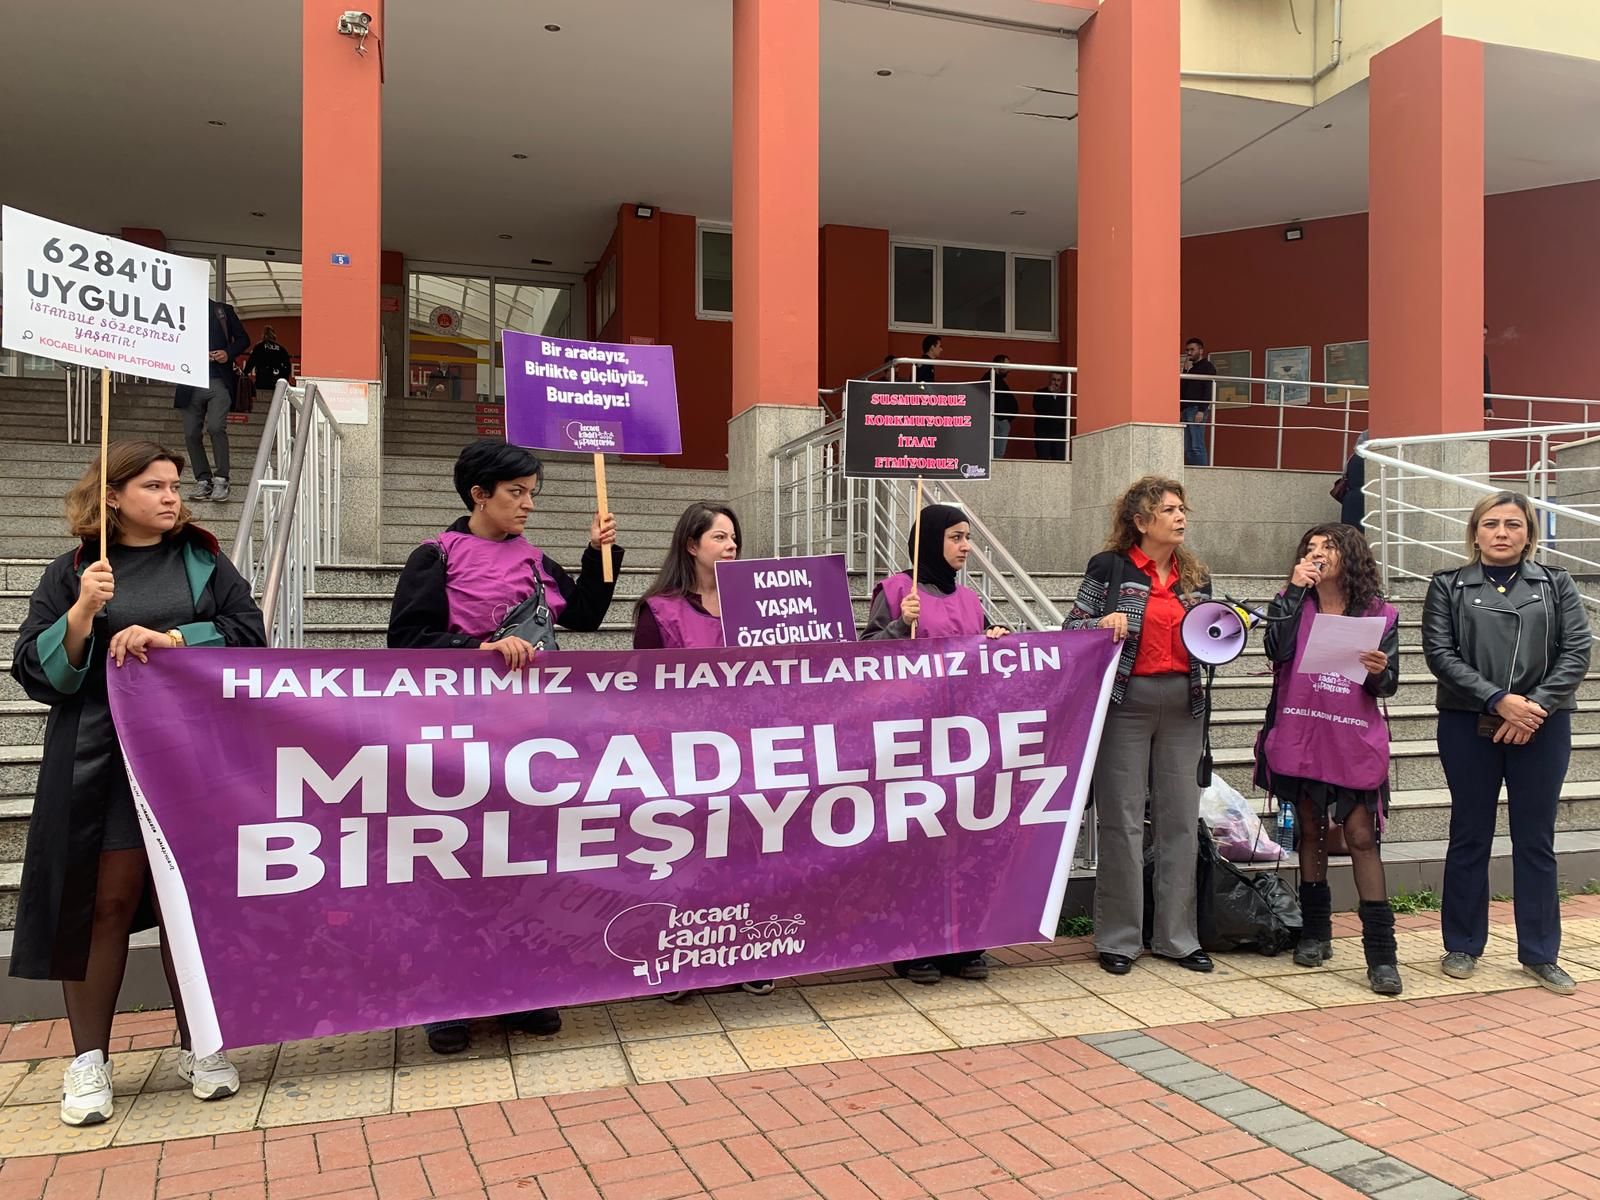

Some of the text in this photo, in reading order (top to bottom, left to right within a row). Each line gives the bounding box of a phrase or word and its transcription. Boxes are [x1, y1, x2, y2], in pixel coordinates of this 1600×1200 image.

[43, 237, 172, 291] 6284'Ü
[27, 268, 187, 331] UYGULA!
[30, 299, 181, 344] İSTANBUL SÖZLEŞMESİ
[74, 326, 137, 349] YAŞATIR!
[39, 336, 176, 372] KOCAELİ KADIN PLATFORMU
[541, 340, 629, 365] Bir aradayız,
[525, 360, 649, 387] Birlikte güçlüyüz,
[546, 386, 631, 410] Buradayız!
[870, 393, 967, 406] SUSMUYORUZ
[864, 414, 972, 427] KORKMUYORUZ
[897, 433, 938, 448] İTAAT
[874, 454, 959, 470] ETMİYORUZ!
[753, 569, 812, 589] KADIN,
[755, 596, 818, 618] YAŞAM,
[737, 620, 833, 647] ÖZGÜRLÜK
[222, 643, 1061, 699] HAKLARIMIZ ve HAYATLARIMIZ İÇİN
[276, 709, 1048, 819] MÜCADELEDE
[668, 903, 751, 929] kocaeli
[658, 924, 737, 951] kadın
